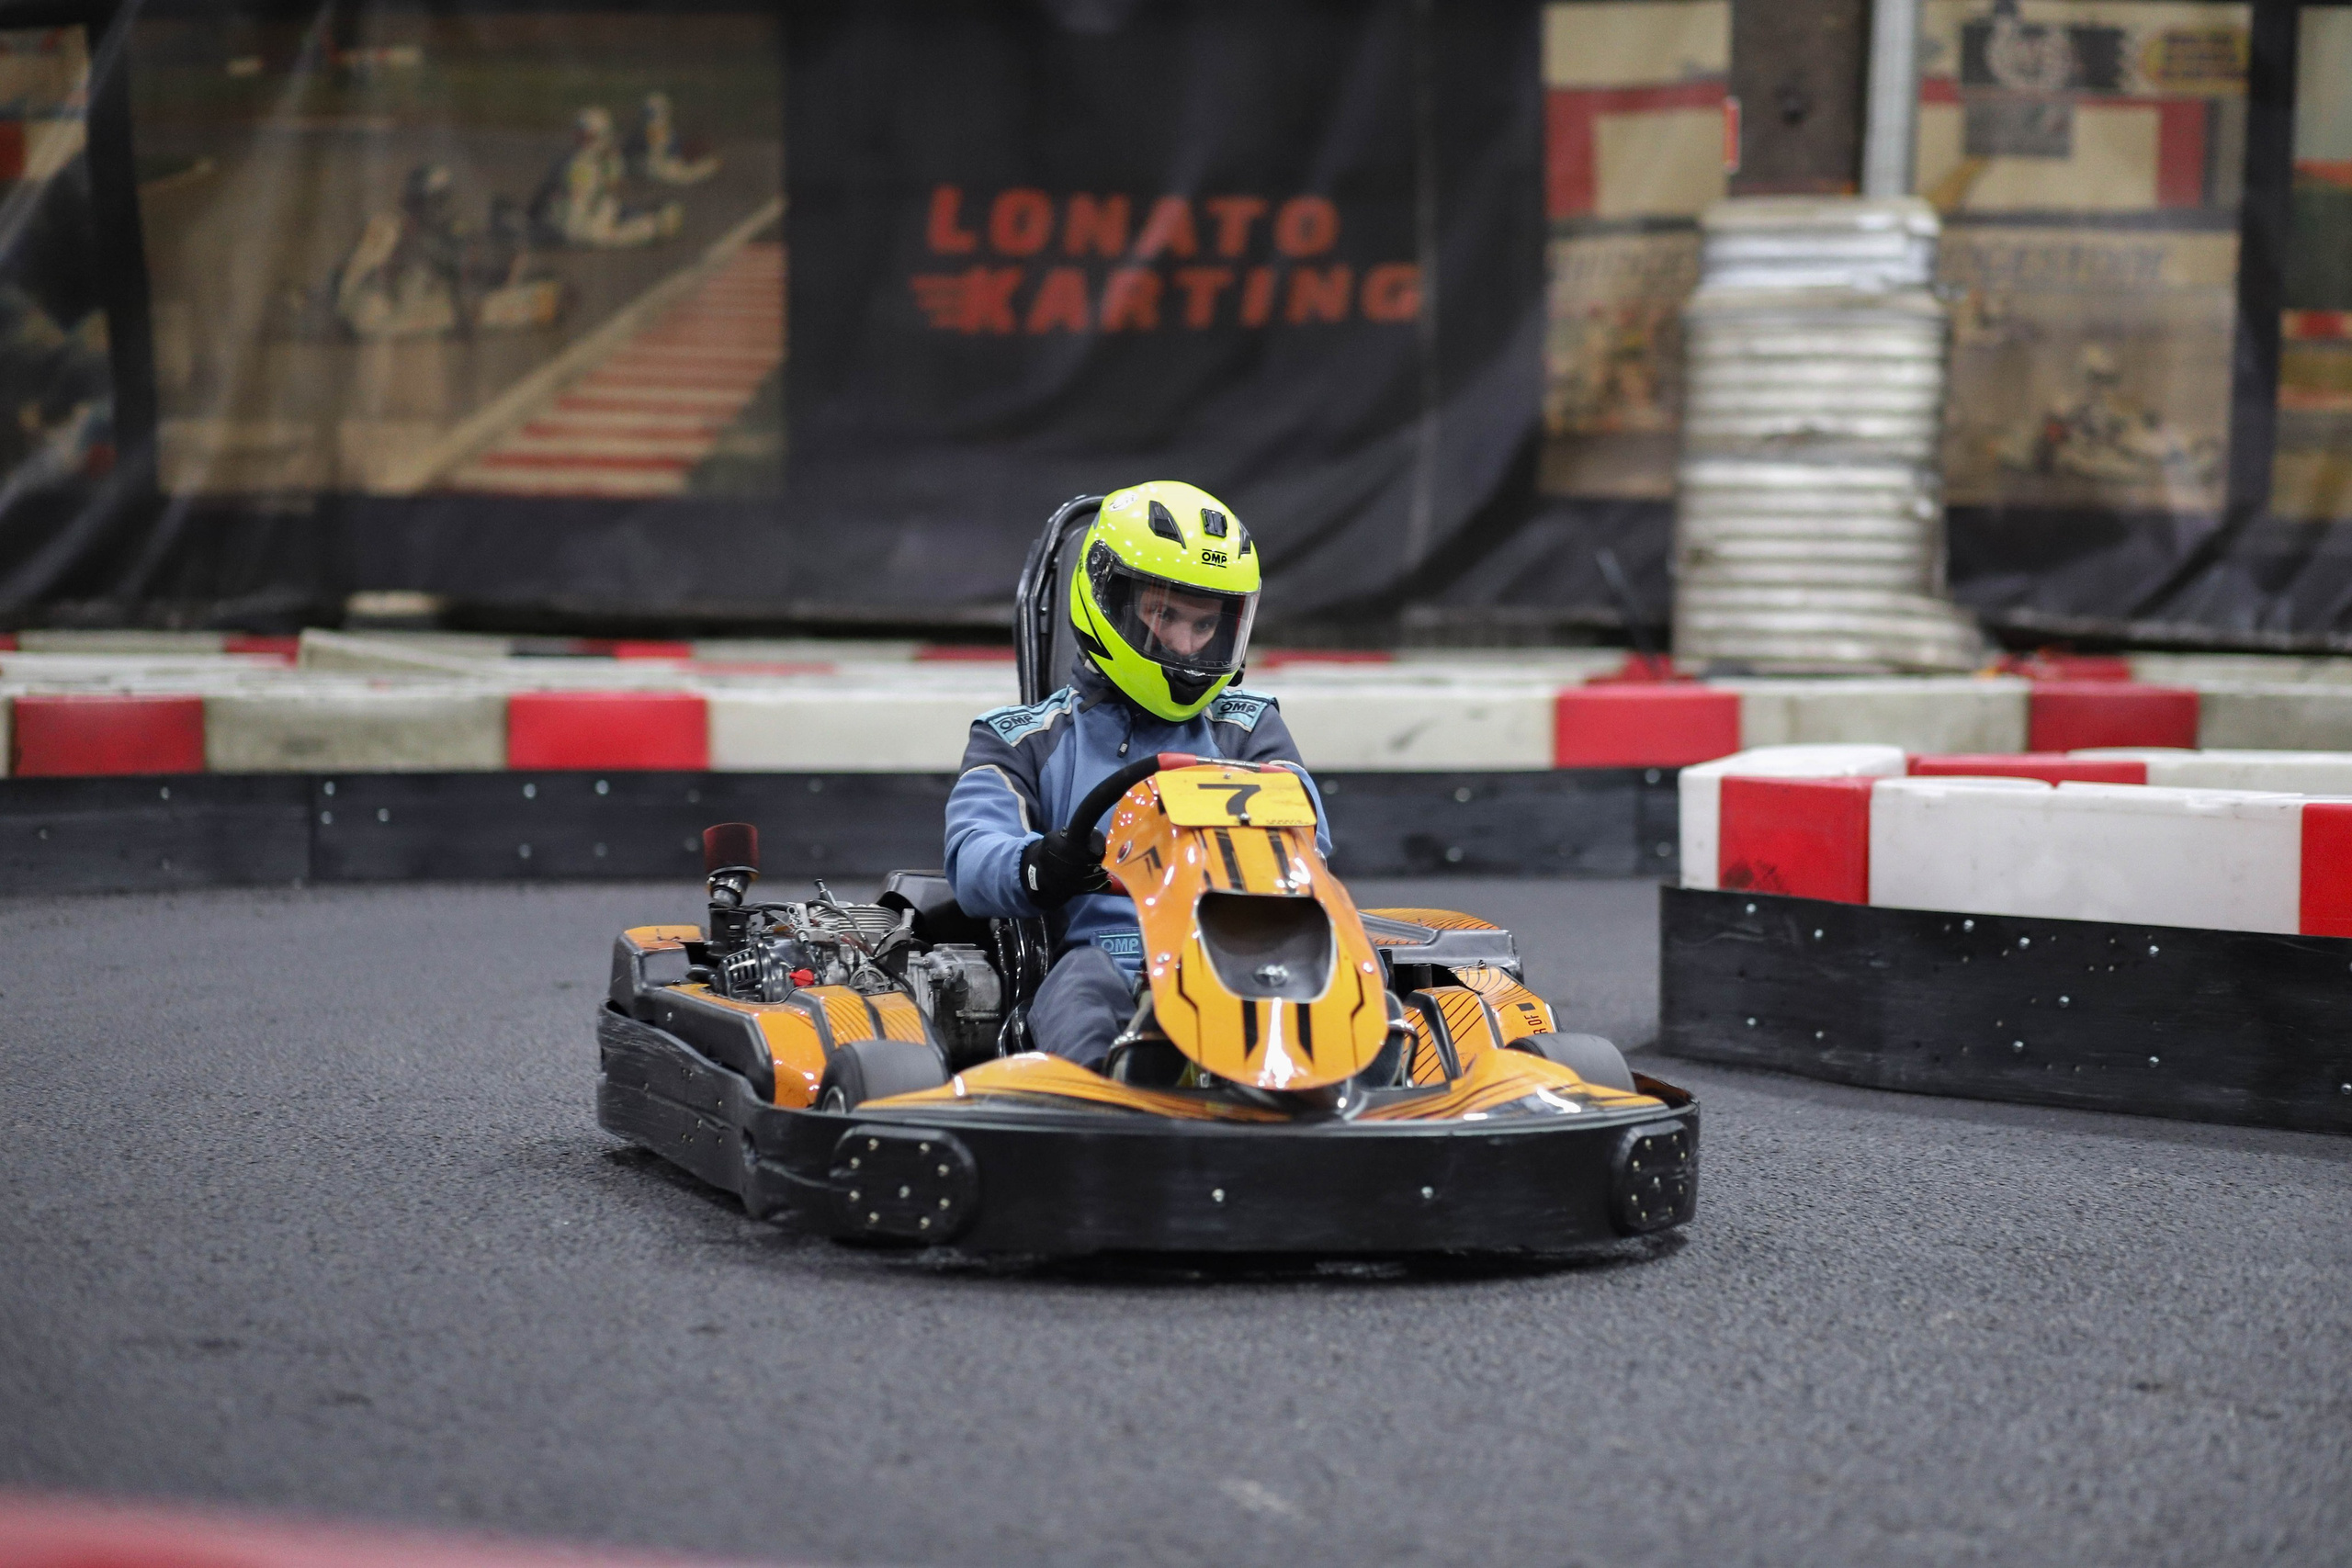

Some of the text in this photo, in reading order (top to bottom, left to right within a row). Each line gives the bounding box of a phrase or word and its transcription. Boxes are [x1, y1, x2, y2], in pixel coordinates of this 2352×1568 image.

[928, 186, 1339, 256] LONATO
[910, 264, 1425, 334] KARTING
[1202, 552, 1227, 564] OMP
[1220, 702, 1257, 713] OMP
[1000, 716, 1033, 729] OMP
[1197, 784, 1261, 817] 7
[1102, 938, 1138, 953] OMP
